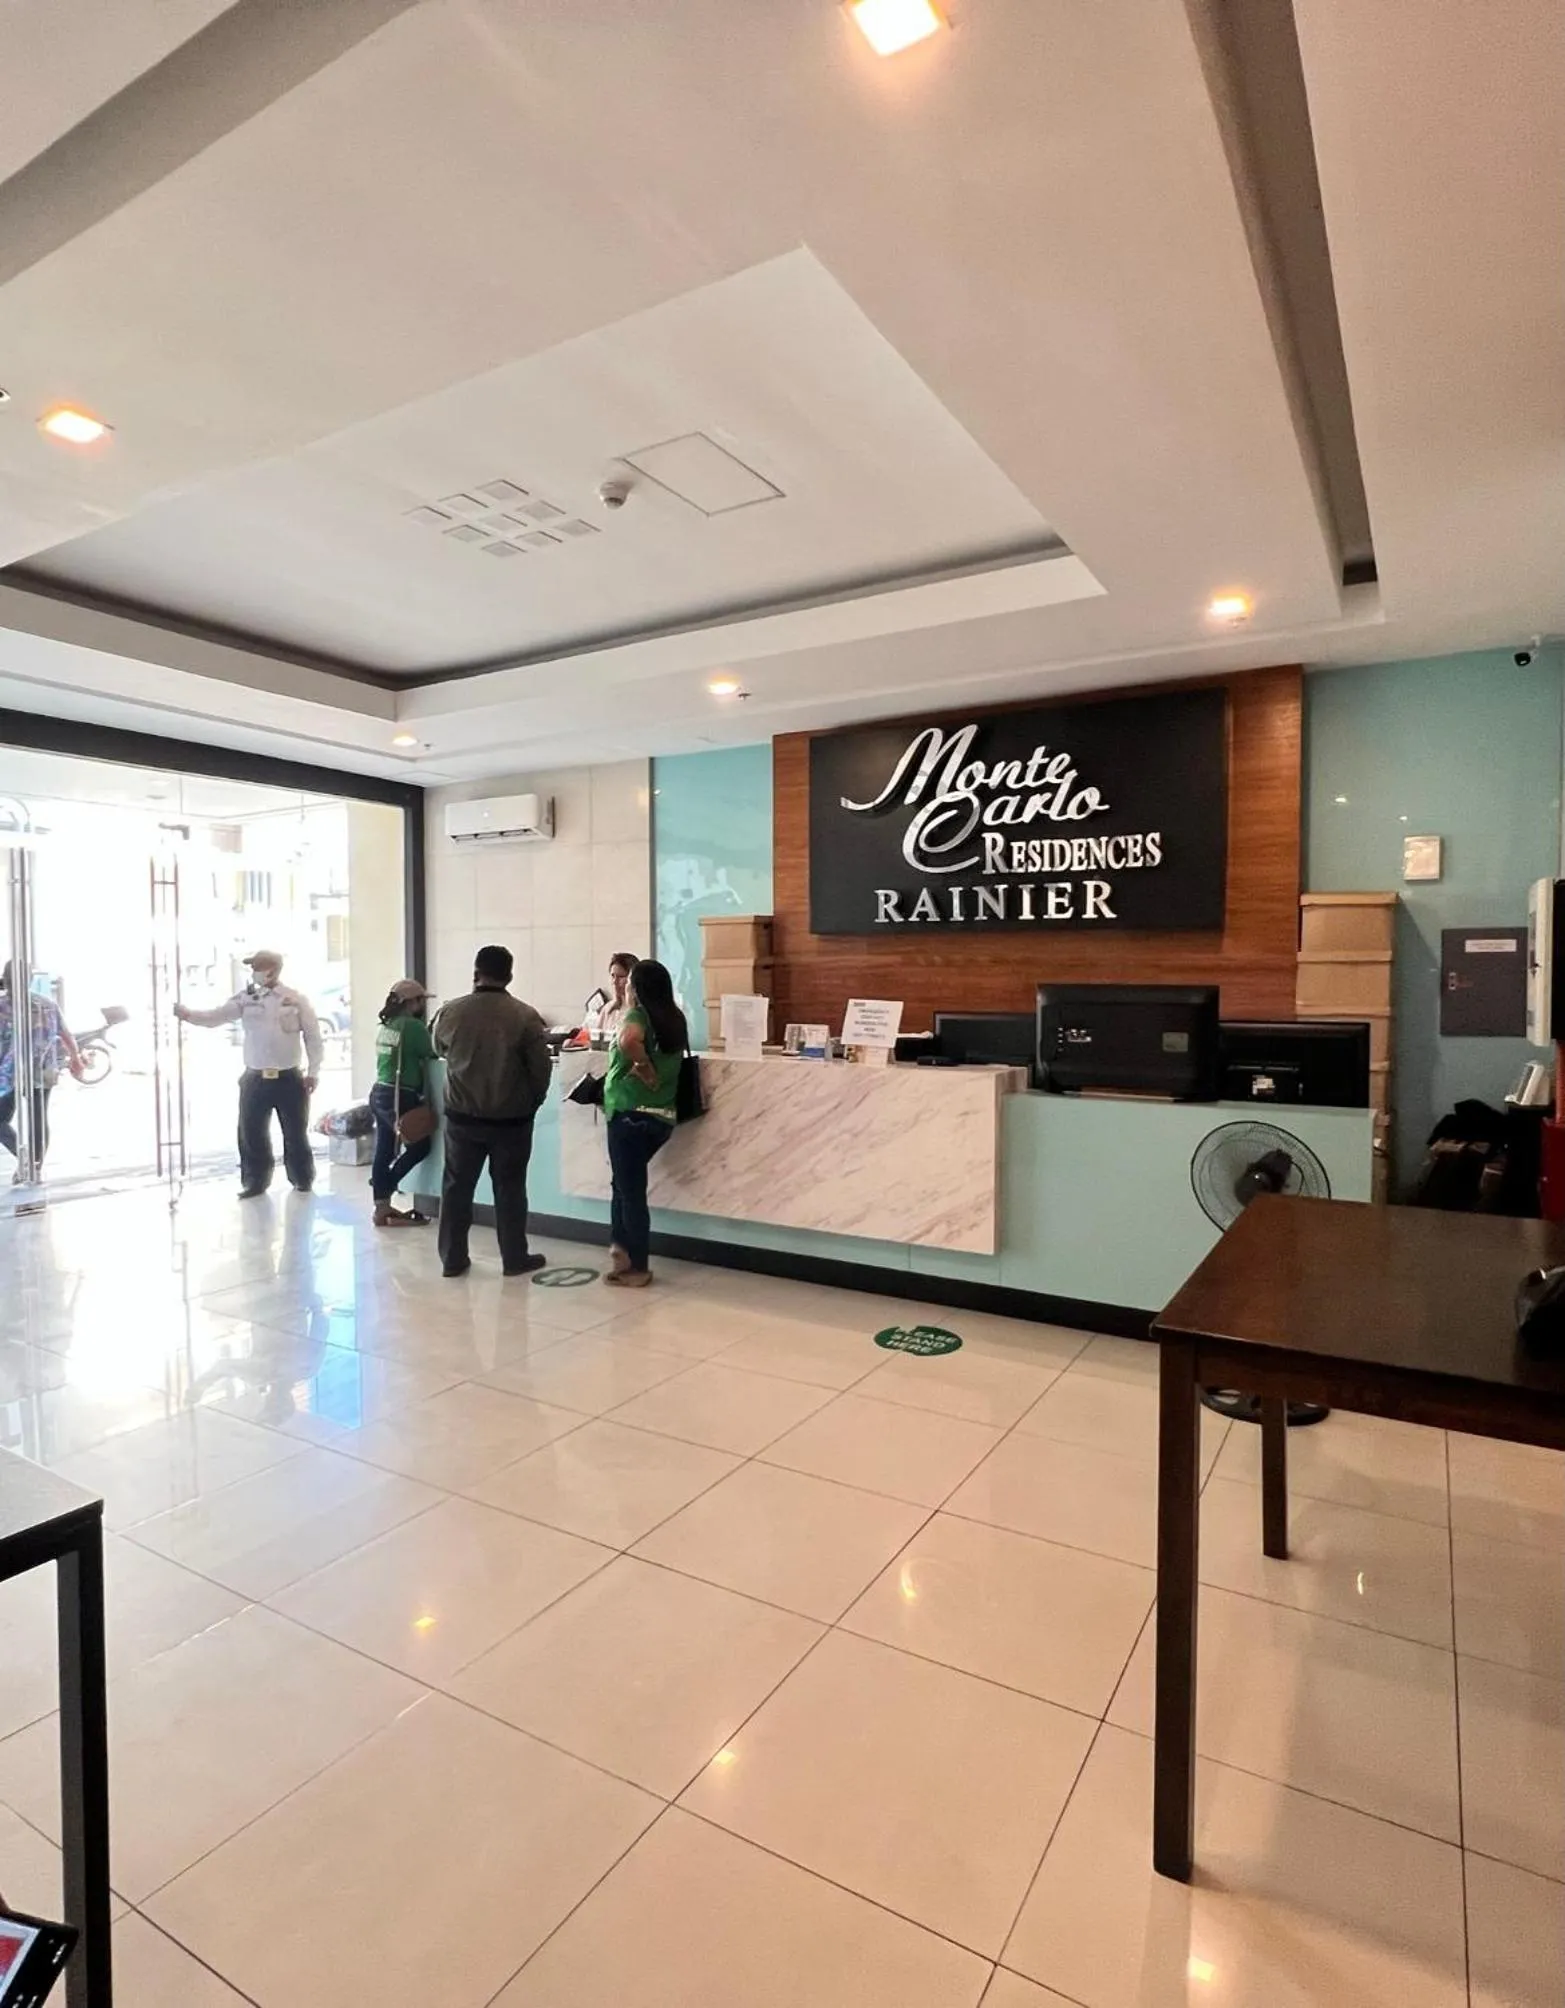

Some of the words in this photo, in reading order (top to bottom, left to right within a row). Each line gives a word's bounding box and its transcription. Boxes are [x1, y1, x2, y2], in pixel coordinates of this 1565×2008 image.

[841, 724, 1077, 811] Monte
[902, 770, 1110, 873] Carlo
[982, 832, 1162, 875] RESIDENCES
[874, 880, 1118, 923] RAINIER
